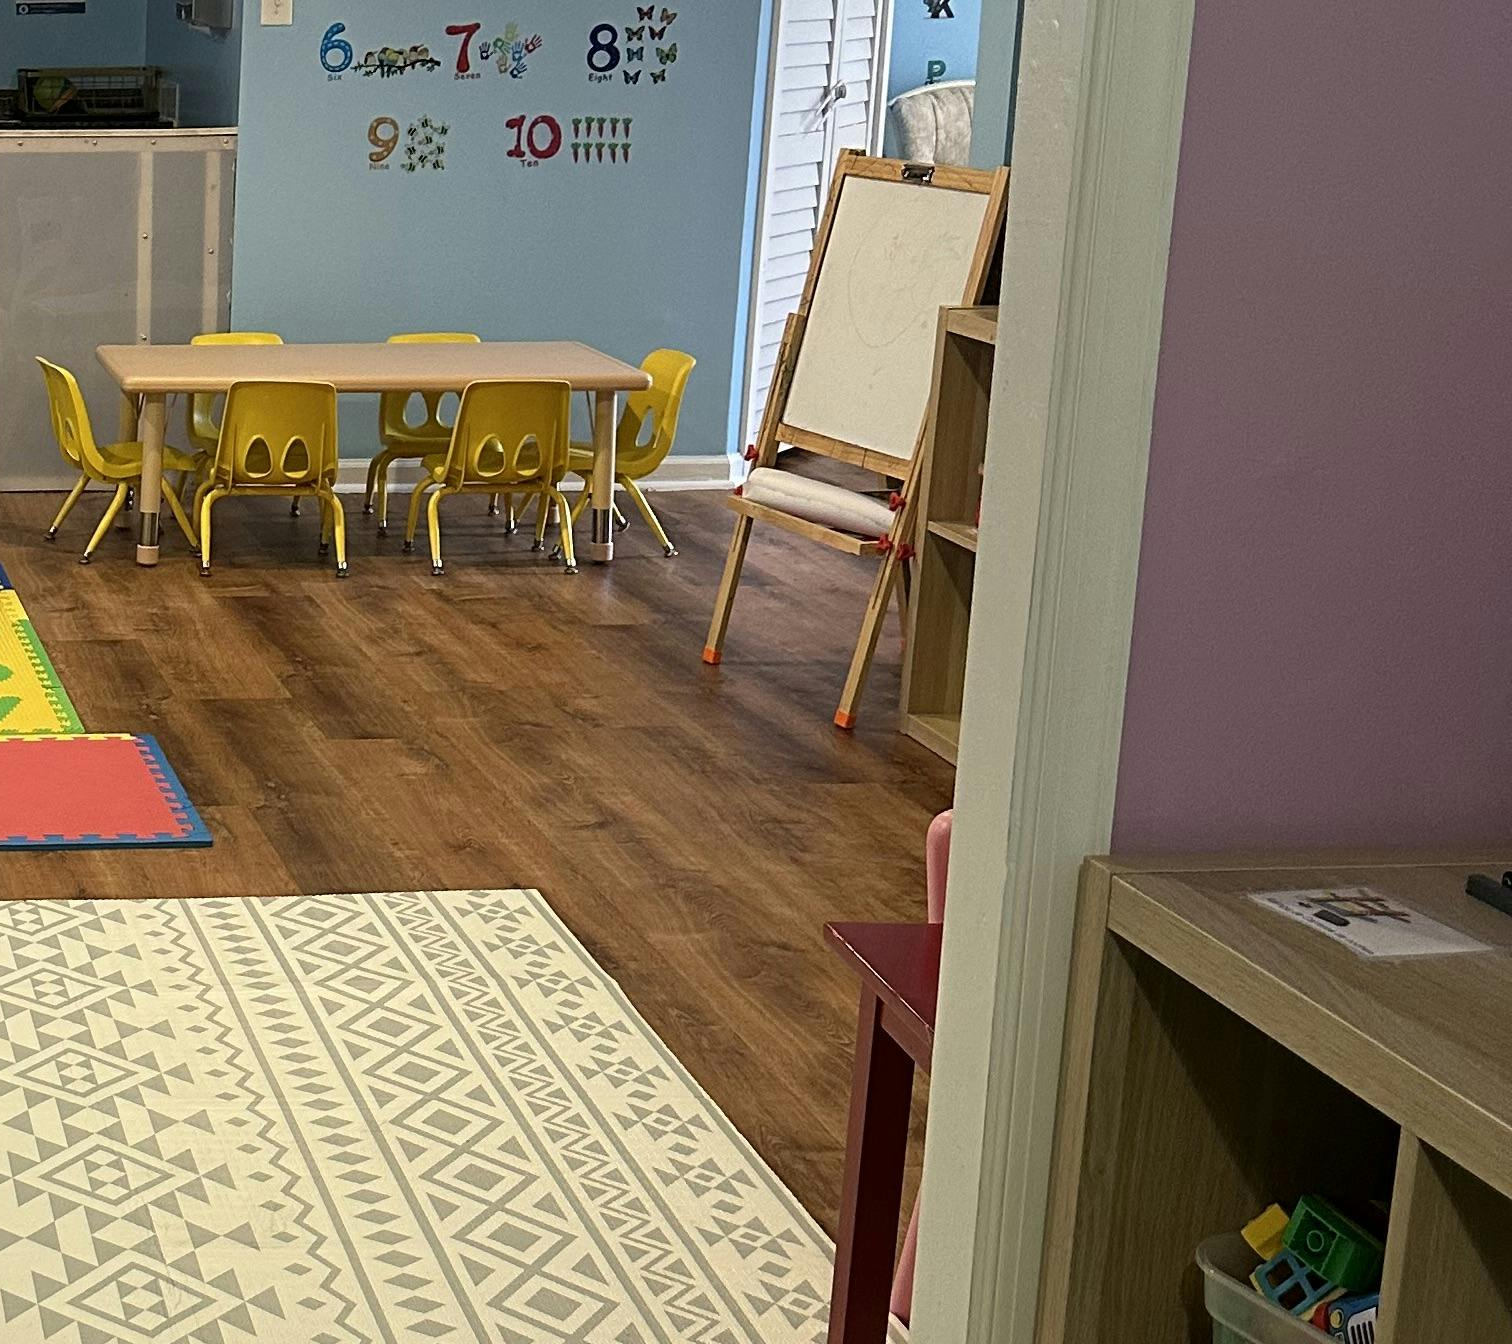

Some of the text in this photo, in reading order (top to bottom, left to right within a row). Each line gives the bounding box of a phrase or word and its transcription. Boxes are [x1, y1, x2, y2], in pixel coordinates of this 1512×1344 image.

[320, 22, 353, 73] 6
[445, 22, 481, 73] 7
[587, 23, 621, 73] 8
[327, 74, 342, 82] Six
[454, 72, 481, 81] Seven
[588, 73, 613, 83] Eight
[926, 60, 946, 85] P
[368, 116, 399, 162] 9
[505, 114, 562, 159] 10
[520, 159, 540, 168] Ten
